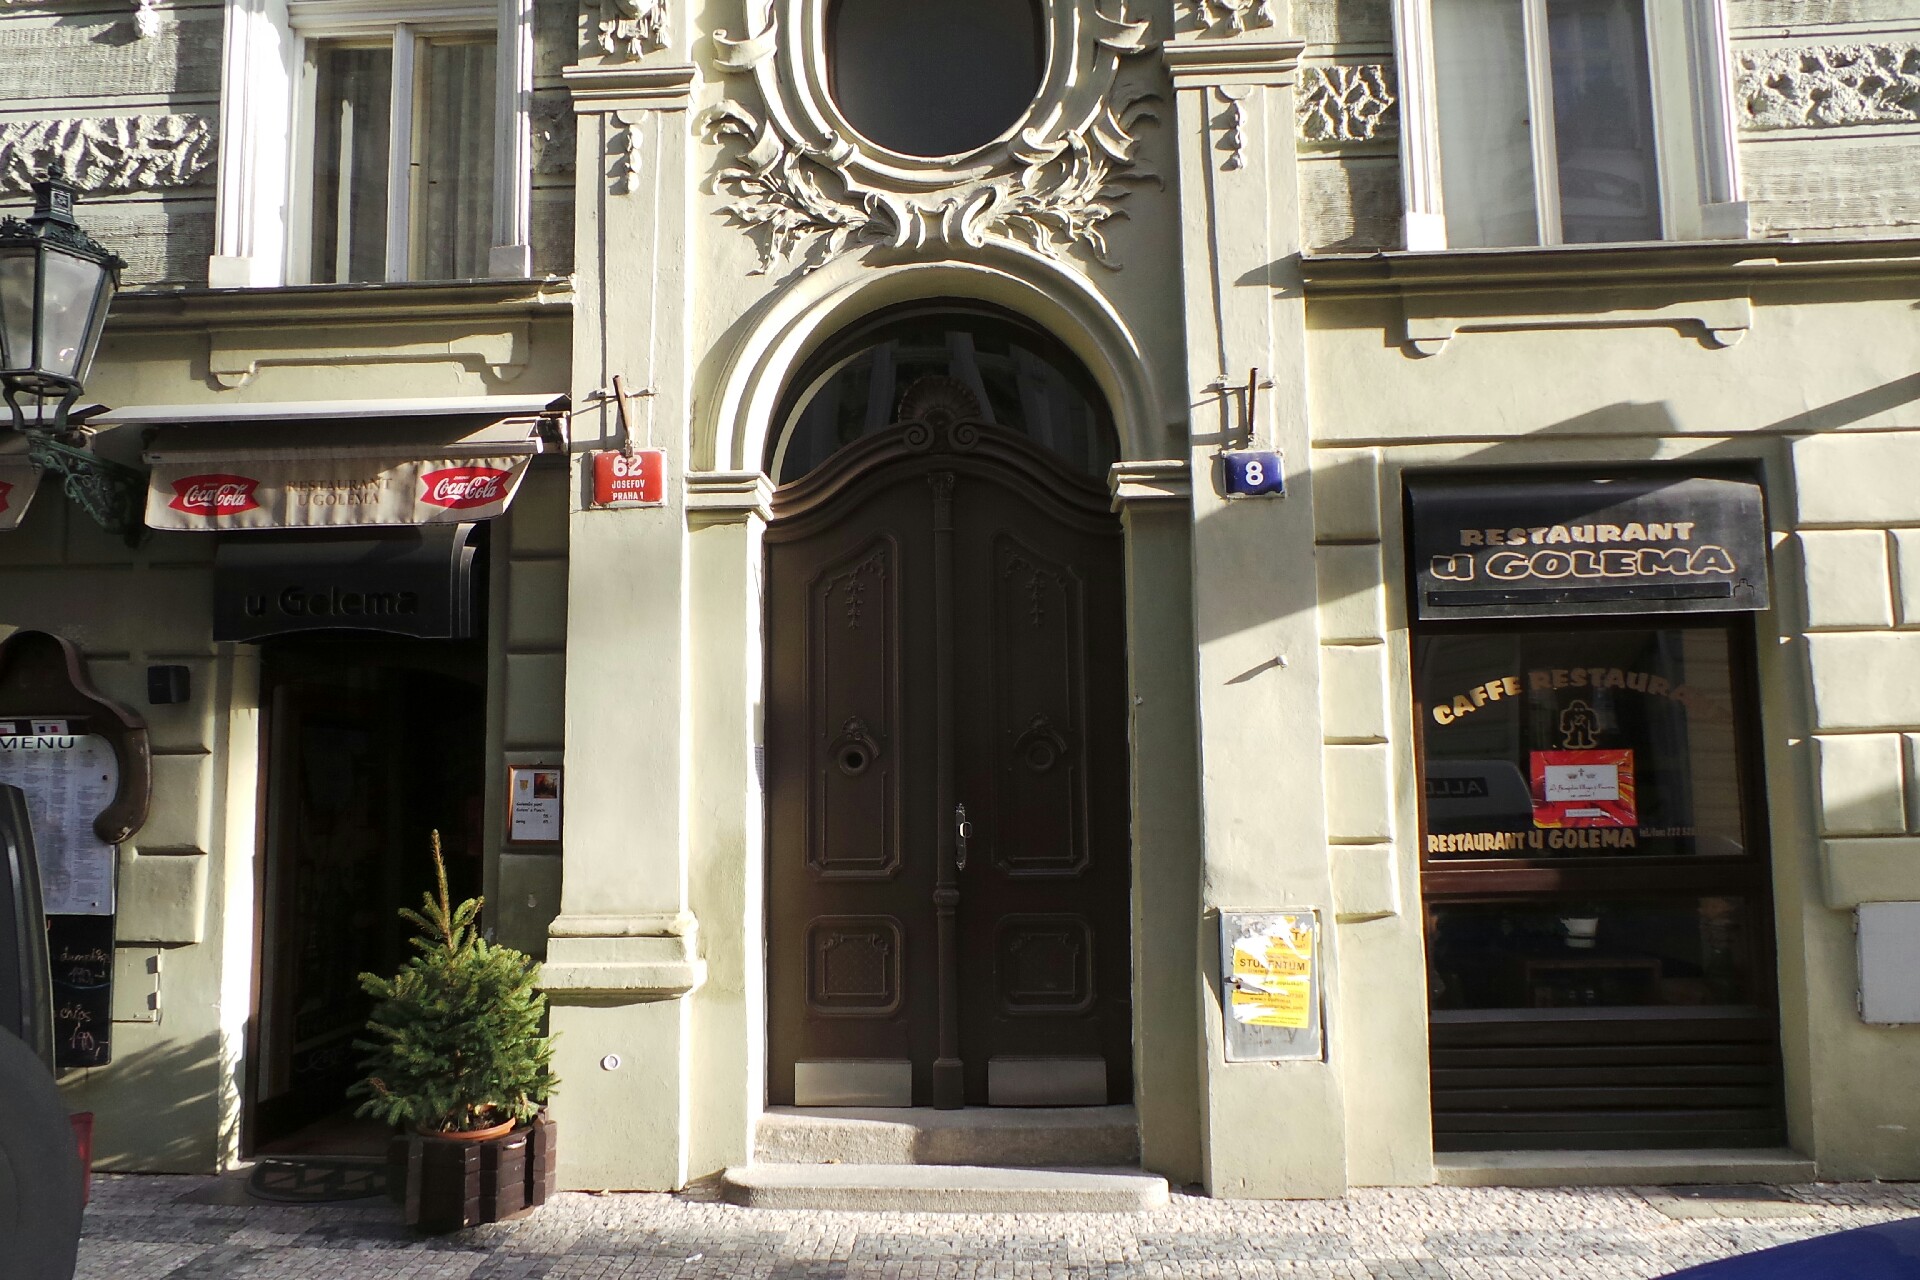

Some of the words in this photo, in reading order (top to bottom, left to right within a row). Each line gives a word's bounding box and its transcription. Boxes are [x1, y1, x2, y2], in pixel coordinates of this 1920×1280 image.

[613, 454, 643, 477] 62
[1245, 461, 1264, 486] 8
[182, 483, 249, 508] Coca-Cola
[288, 477, 392, 491] RESTAURANT
[433, 475, 500, 501] Coca-Cola
[611, 479, 645, 489] JOSEFOV
[612, 491, 638, 500] PRAHA
[639, 491, 644, 500] 1
[297, 494, 310, 506] U
[312, 492, 380, 506] GOLEMA
[1459, 522, 1695, 547] RESTAURANT
[1485, 546, 1737, 580] GOLEMA
[245, 594, 267, 616] u
[278, 585, 419, 617] Golema
[1432, 676, 1523, 725] CAFFE
[0, 737, 74, 749] MENU
[1428, 832, 1526, 853] RESTAURANT
[1549, 827, 1637, 849] GOLEMA
